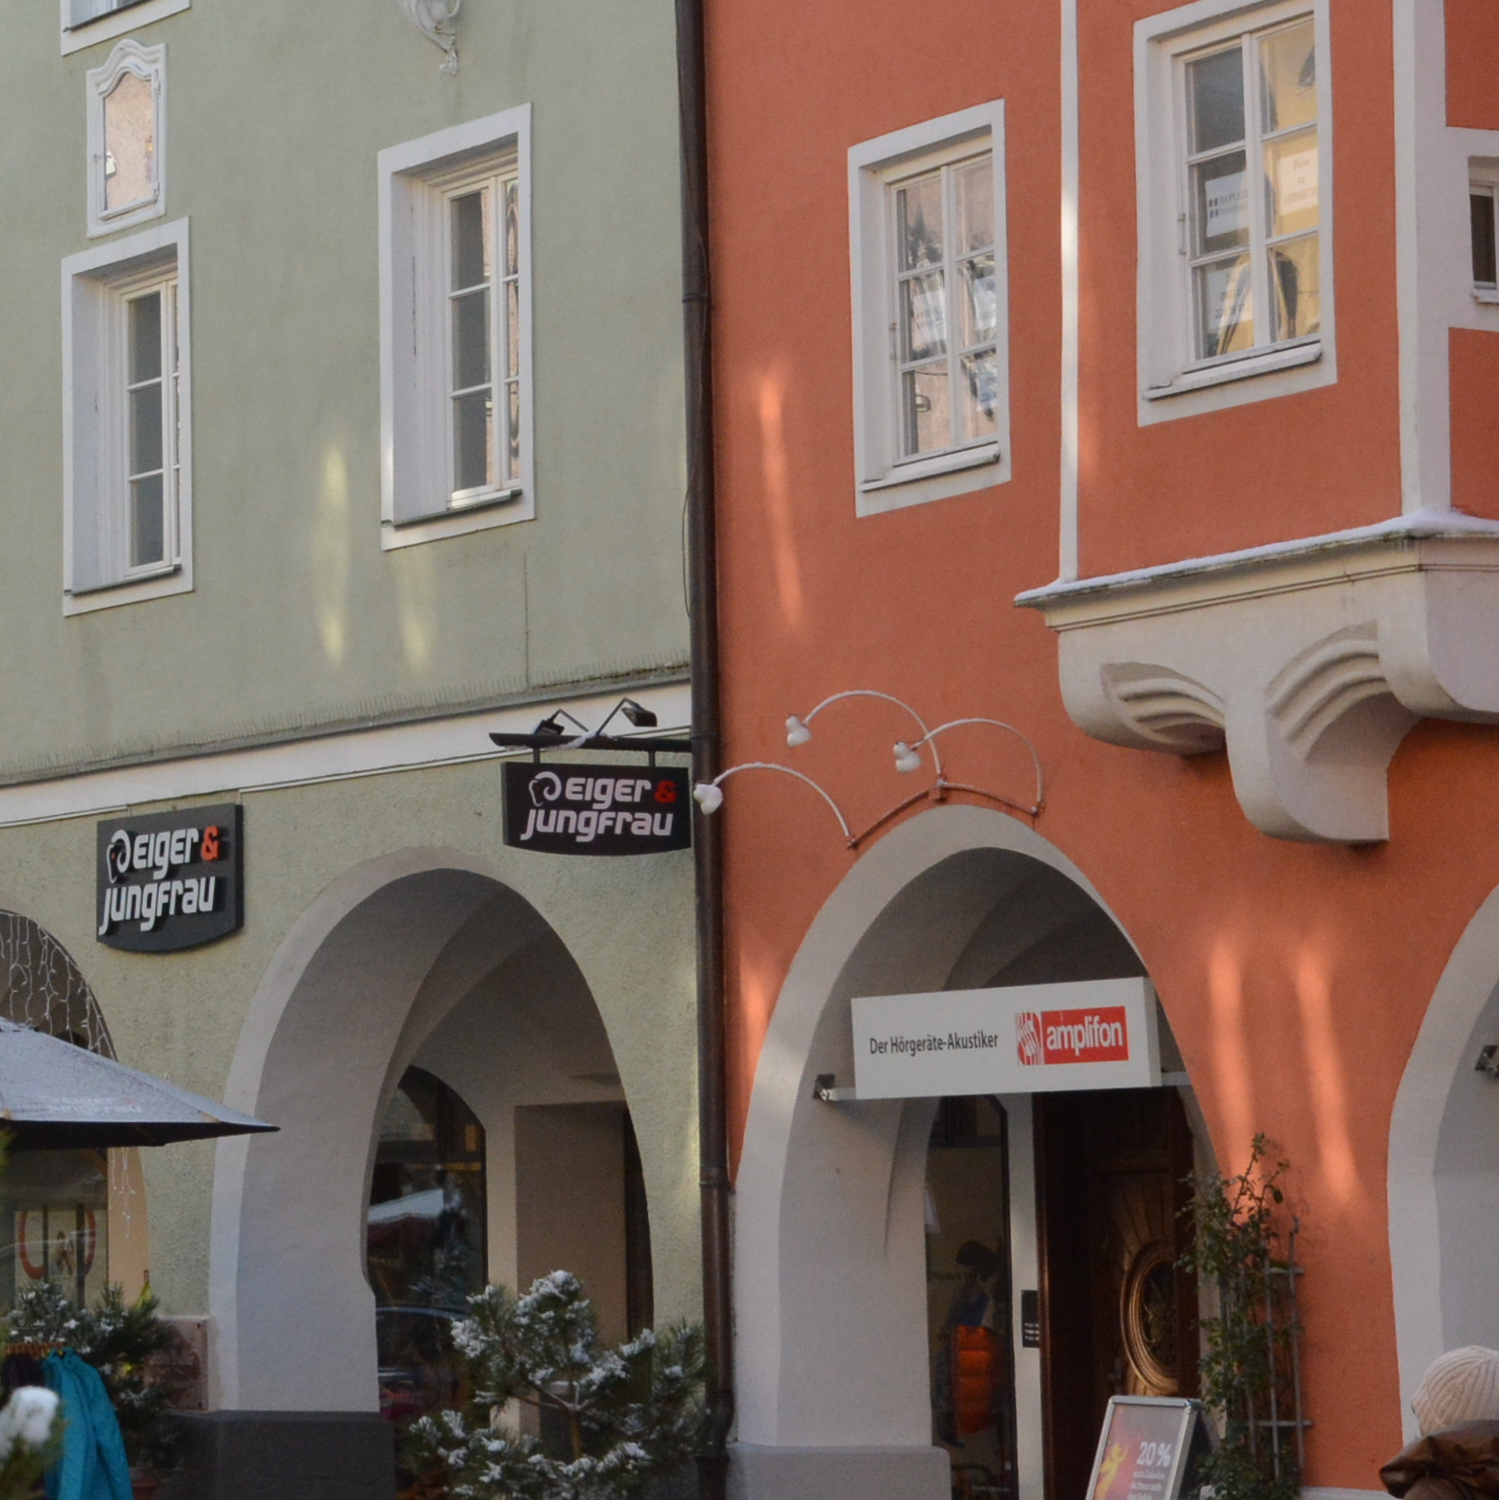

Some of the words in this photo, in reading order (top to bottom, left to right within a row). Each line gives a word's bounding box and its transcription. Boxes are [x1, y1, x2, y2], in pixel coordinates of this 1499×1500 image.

[655, 780, 677, 804] &
[201, 825, 220, 861] &
[869, 1037, 888, 1055] Der
[890, 1031, 999, 1057] Hörgeräte-Akustiker
[1046, 1015, 1124, 1056] amplifon
[1136, 1441, 1157, 1466] 20
[1156, 1443, 1172, 1467] %
